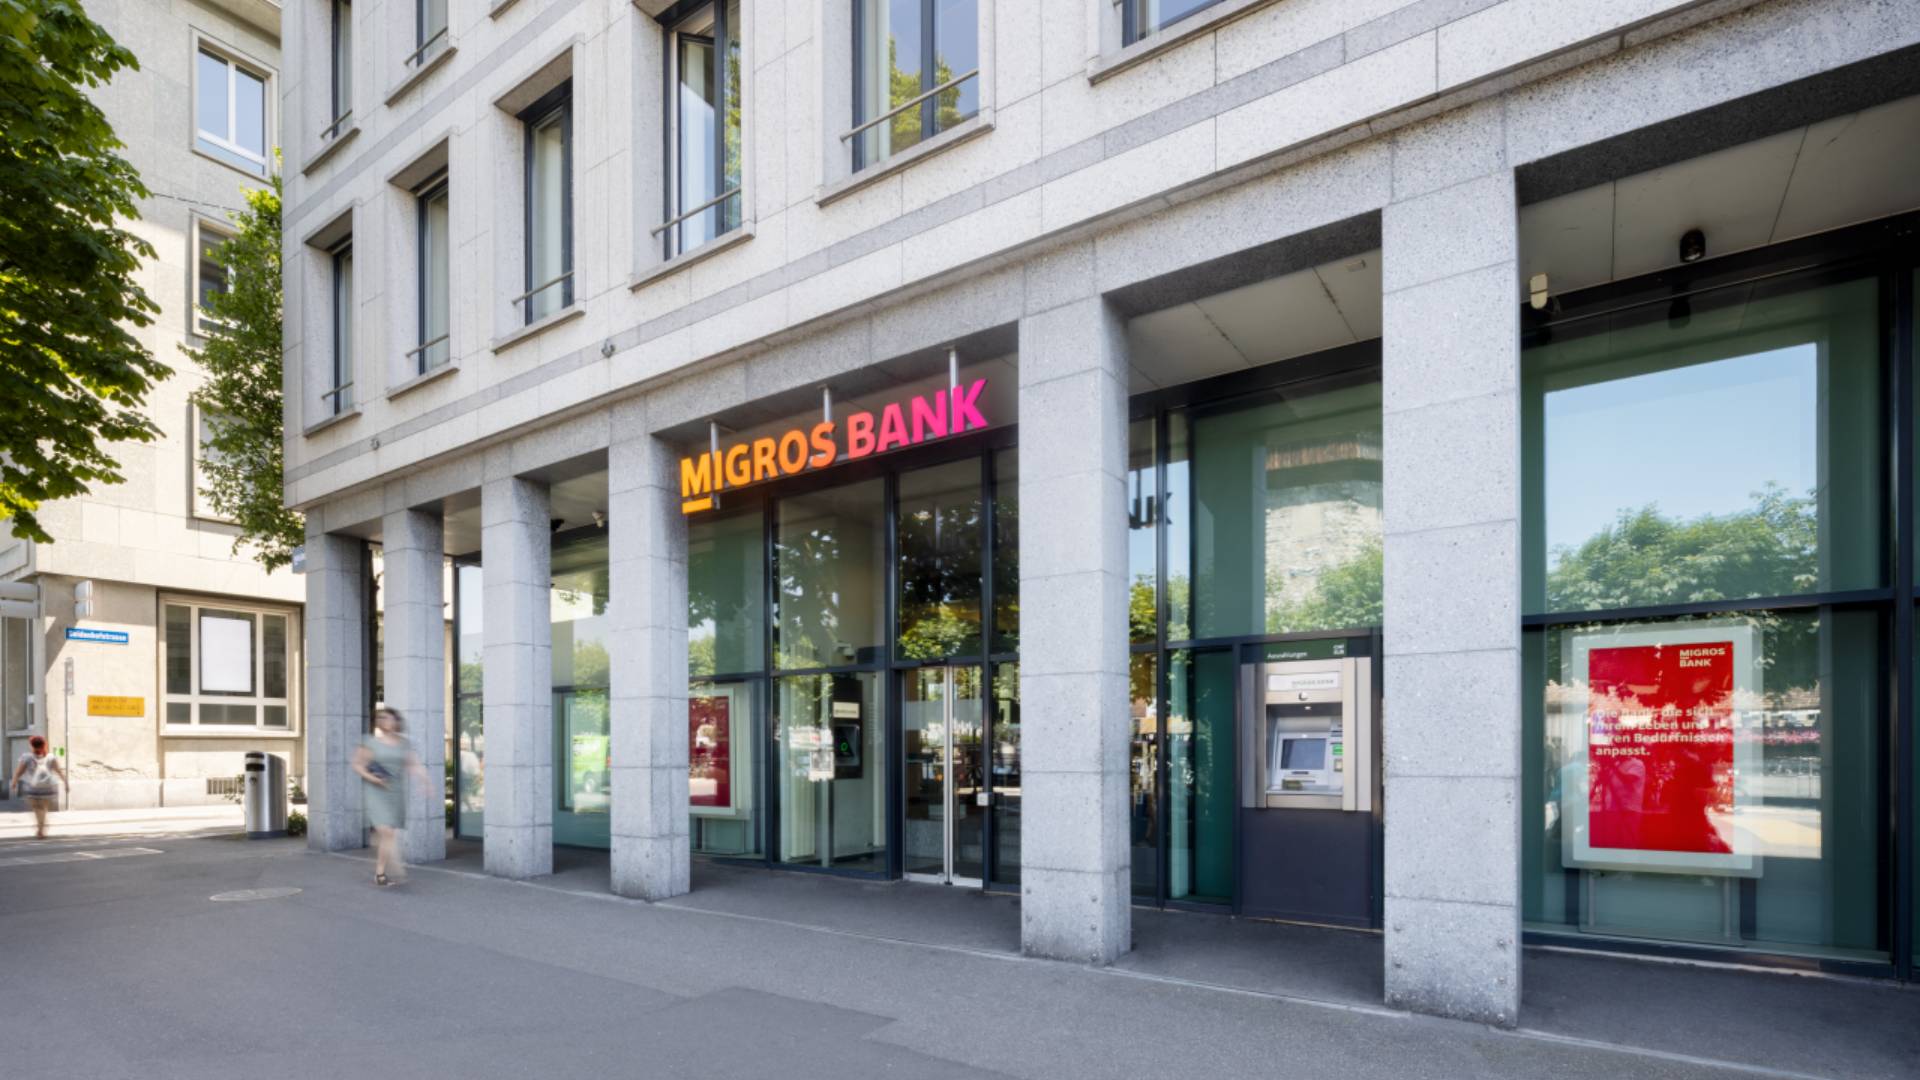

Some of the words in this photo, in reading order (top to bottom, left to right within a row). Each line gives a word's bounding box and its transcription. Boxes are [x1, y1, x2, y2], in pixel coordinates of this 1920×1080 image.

[681, 421, 836, 498] MIGROS
[848, 379, 988, 459] BANK
[1680, 648, 1725, 657] MIGROS
[1680, 659, 1712, 667] BANK
[1661, 706, 1682, 717] die
[1595, 732, 1631, 743] ren
[1595, 746, 1651, 757] anpasst.
